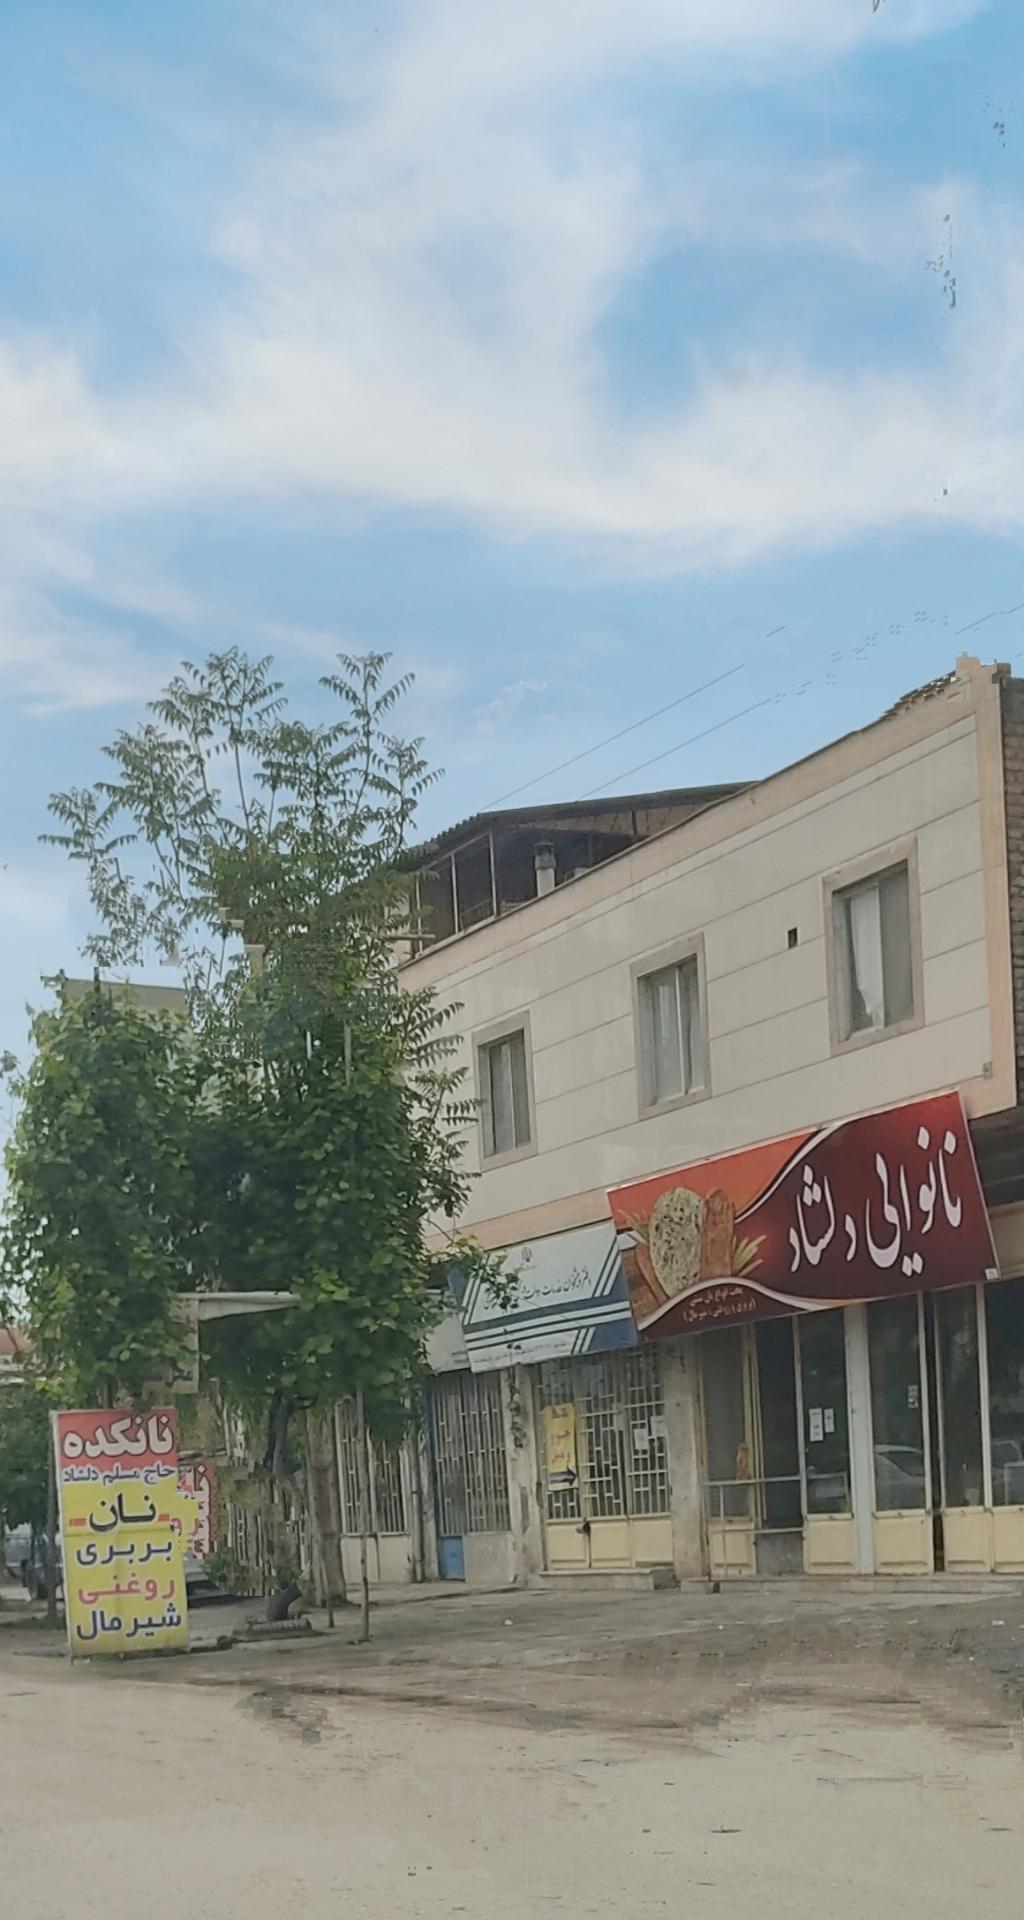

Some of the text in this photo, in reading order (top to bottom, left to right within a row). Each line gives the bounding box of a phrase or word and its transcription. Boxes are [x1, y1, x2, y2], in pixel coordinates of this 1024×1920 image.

[788, 1126, 962, 1277] نانوایی دلشاد
[63, 1412, 175, 1459] نانکده
[64, 1467, 100, 1483] دلشاد
[102, 1465, 141, 1487] مسلم
[144, 1462, 176, 1483] حاج
[89, 1492, 158, 1533] نان
[76, 1540, 173, 1566] بربری
[78, 1574, 176, 1605] روغنی
